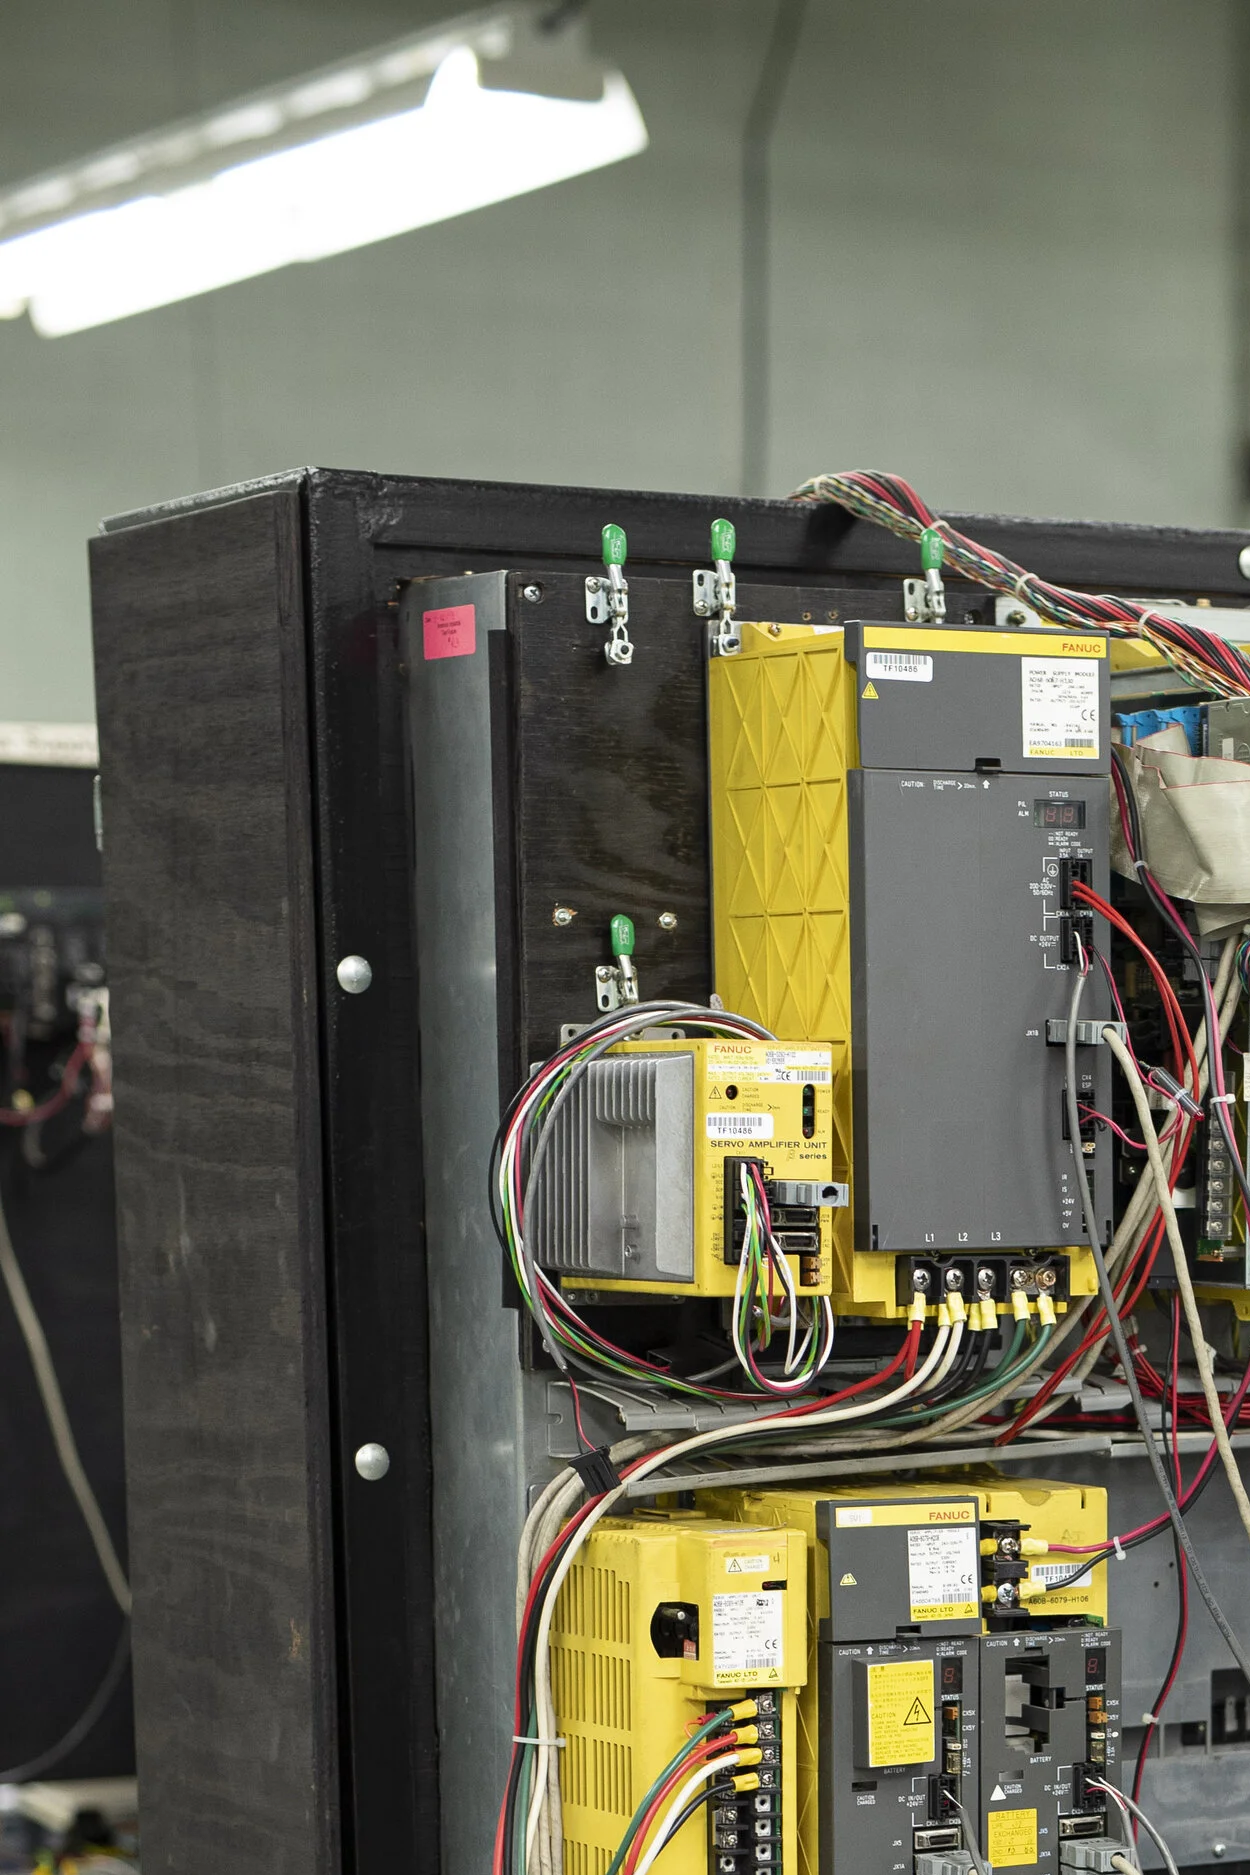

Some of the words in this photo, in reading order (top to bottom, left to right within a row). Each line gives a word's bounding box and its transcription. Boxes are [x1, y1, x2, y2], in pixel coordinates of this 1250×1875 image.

[1062, 643, 1101, 653] FANUC
[883, 664, 918, 673] TF10486
[714, 1045, 752, 1054] FANUC
[718, 1127, 753, 1135] TF10486
[710, 1140, 744, 1148] SERVO
[748, 1141, 800, 1149] AMPLIFIER
[925, 1233, 935, 1242] L1
[958, 1232, 968, 1241] L2
[991, 1232, 1001, 1241] L3
[929, 1510, 970, 1521] FANUC
[995, 1810, 1031, 1819] BATTERY
[993, 1828, 1033, 1838] EXCHANGED
